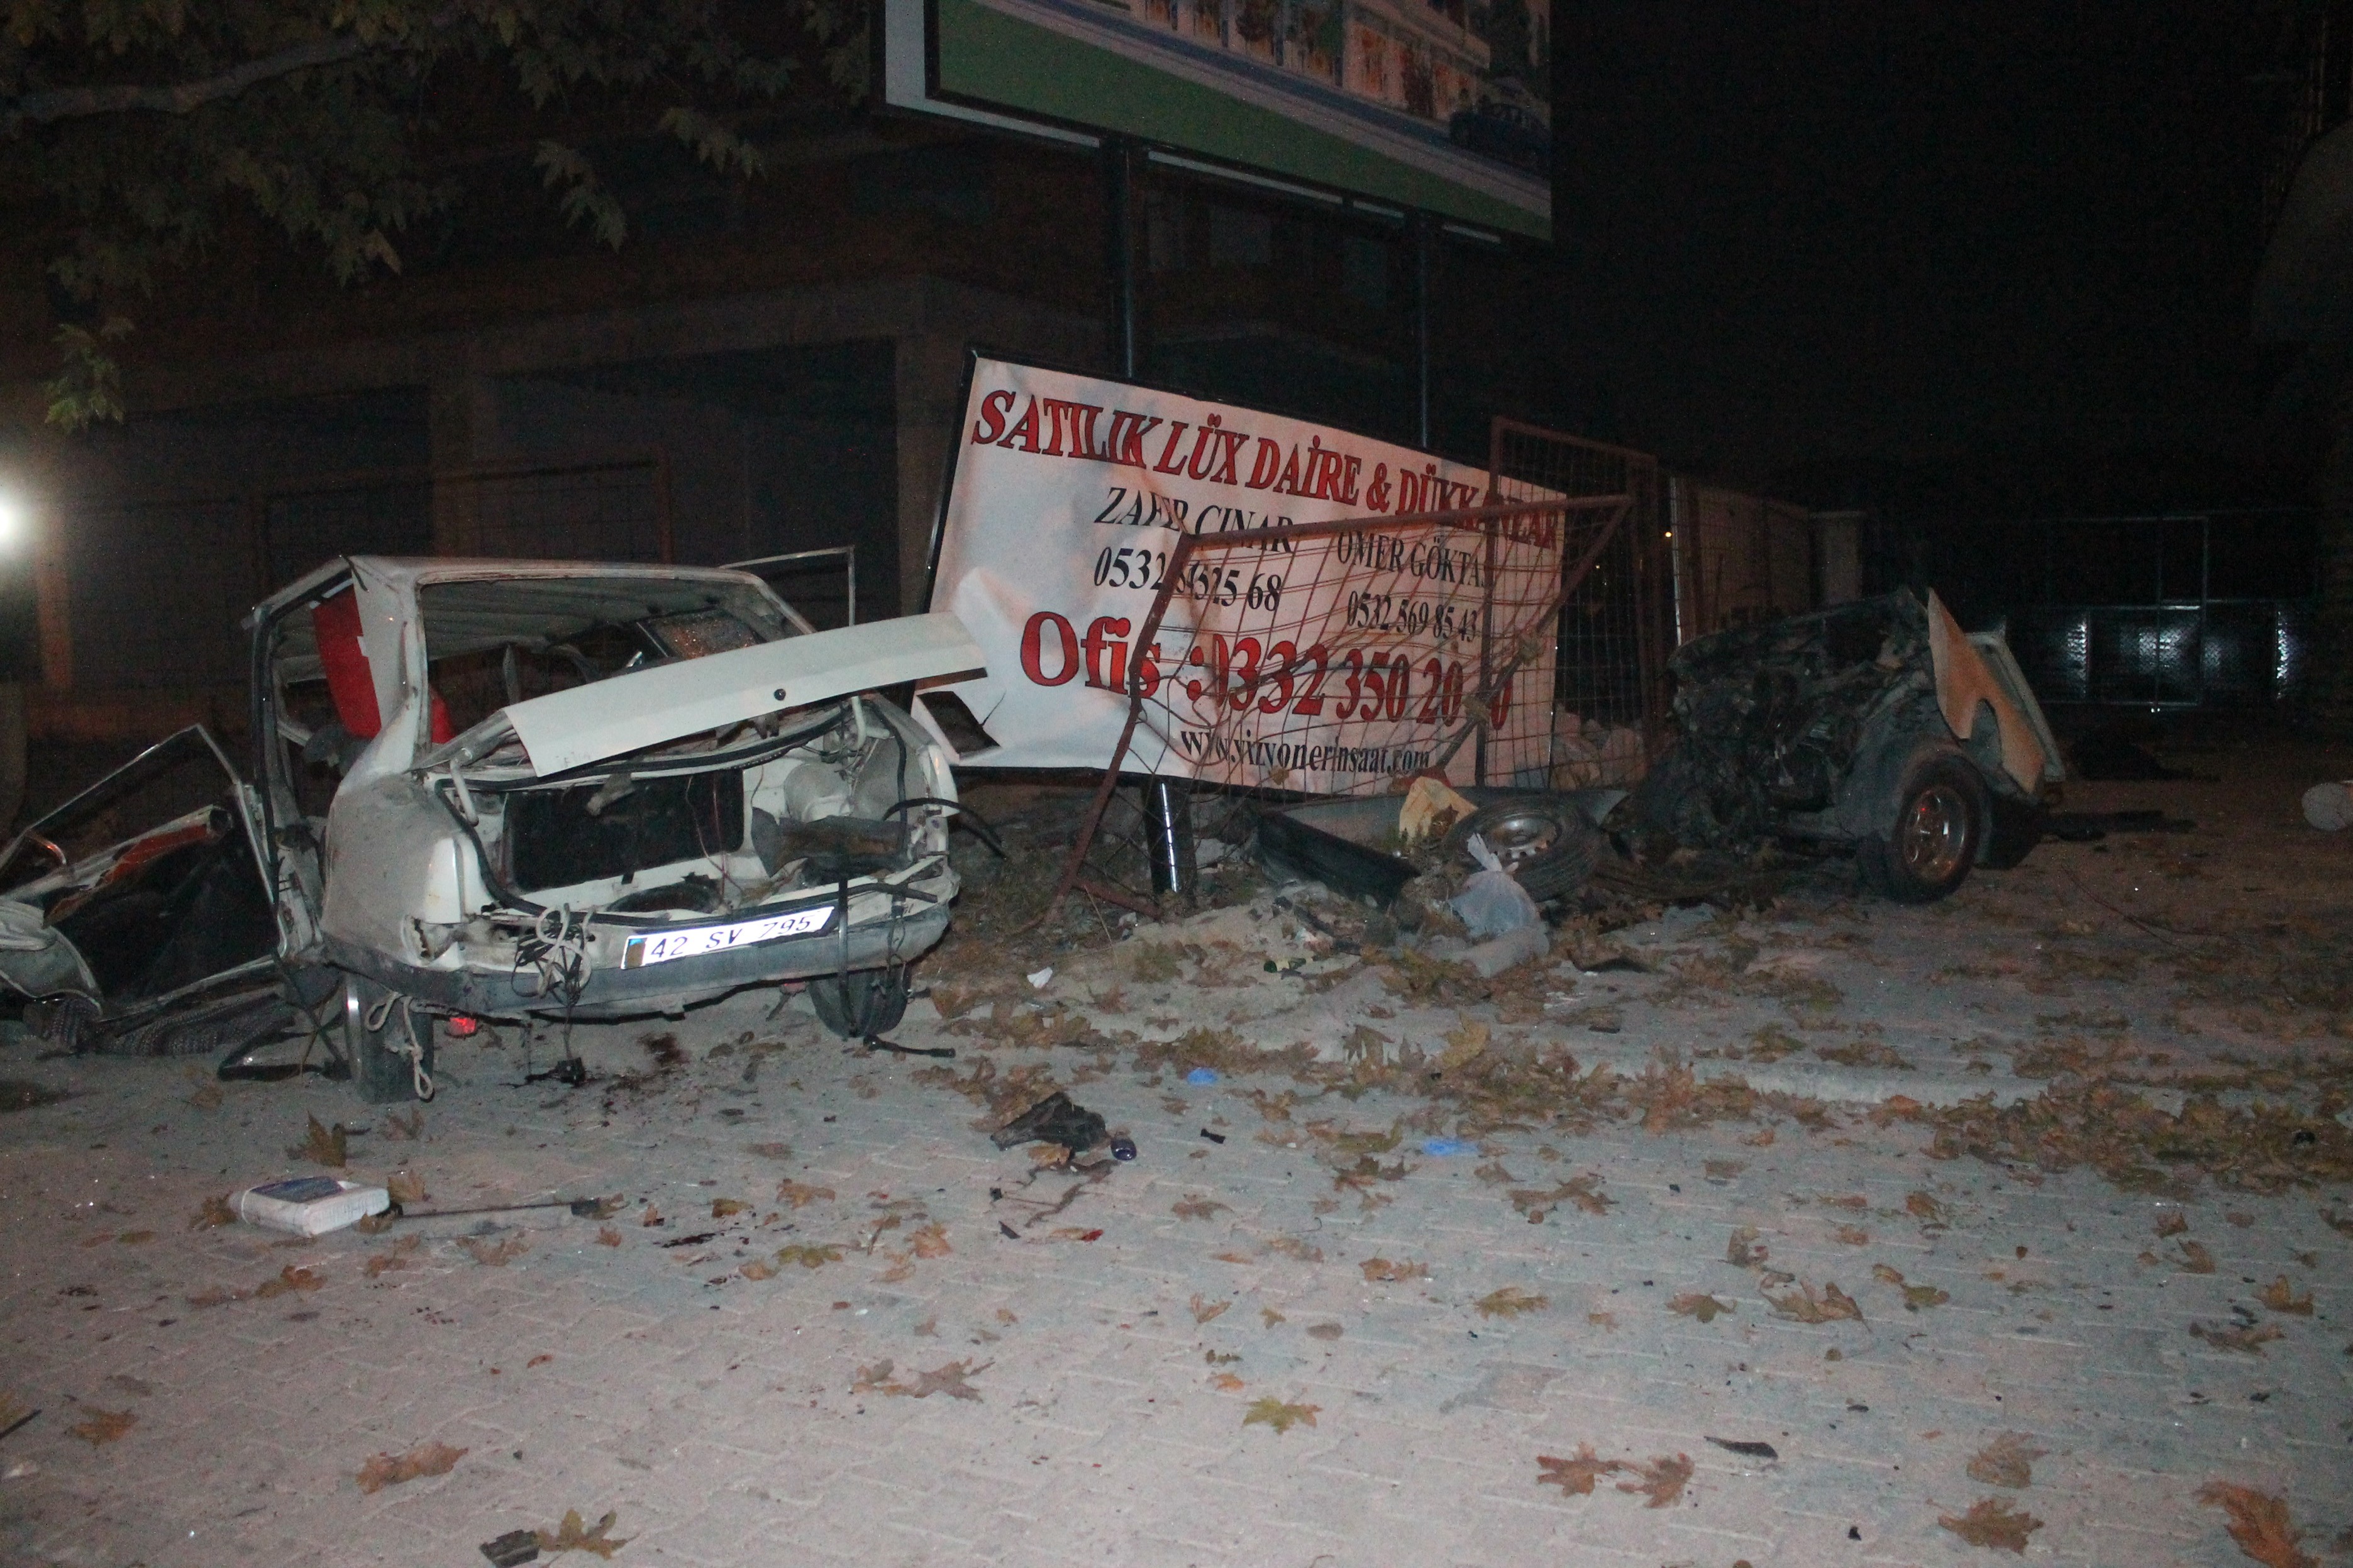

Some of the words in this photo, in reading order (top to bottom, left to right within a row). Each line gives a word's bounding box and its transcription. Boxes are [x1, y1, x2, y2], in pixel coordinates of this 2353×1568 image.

[971, 390, 1163, 469] SATILIK
[1153, 413, 1249, 485] LÜX
[1245, 434, 1361, 505] DAİRE
[1366, 463, 1392, 513] &
[1093, 546, 1166, 590] 0532
[1248, 573, 1282, 612] 68
[1410, 536, 1485, 588] GÖKTA
[1348, 591, 1391, 630] 0532
[1397, 599, 1429, 635] 569
[1434, 605, 1454, 639] 85
[1021, 611, 1161, 698] Ofis
[1336, 648, 1410, 722] 350
[1416, 658, 1463, 727] 20
[651, 936, 689, 958] 42
[706, 929, 743, 949] SV
[759, 916, 811, 938] 795
